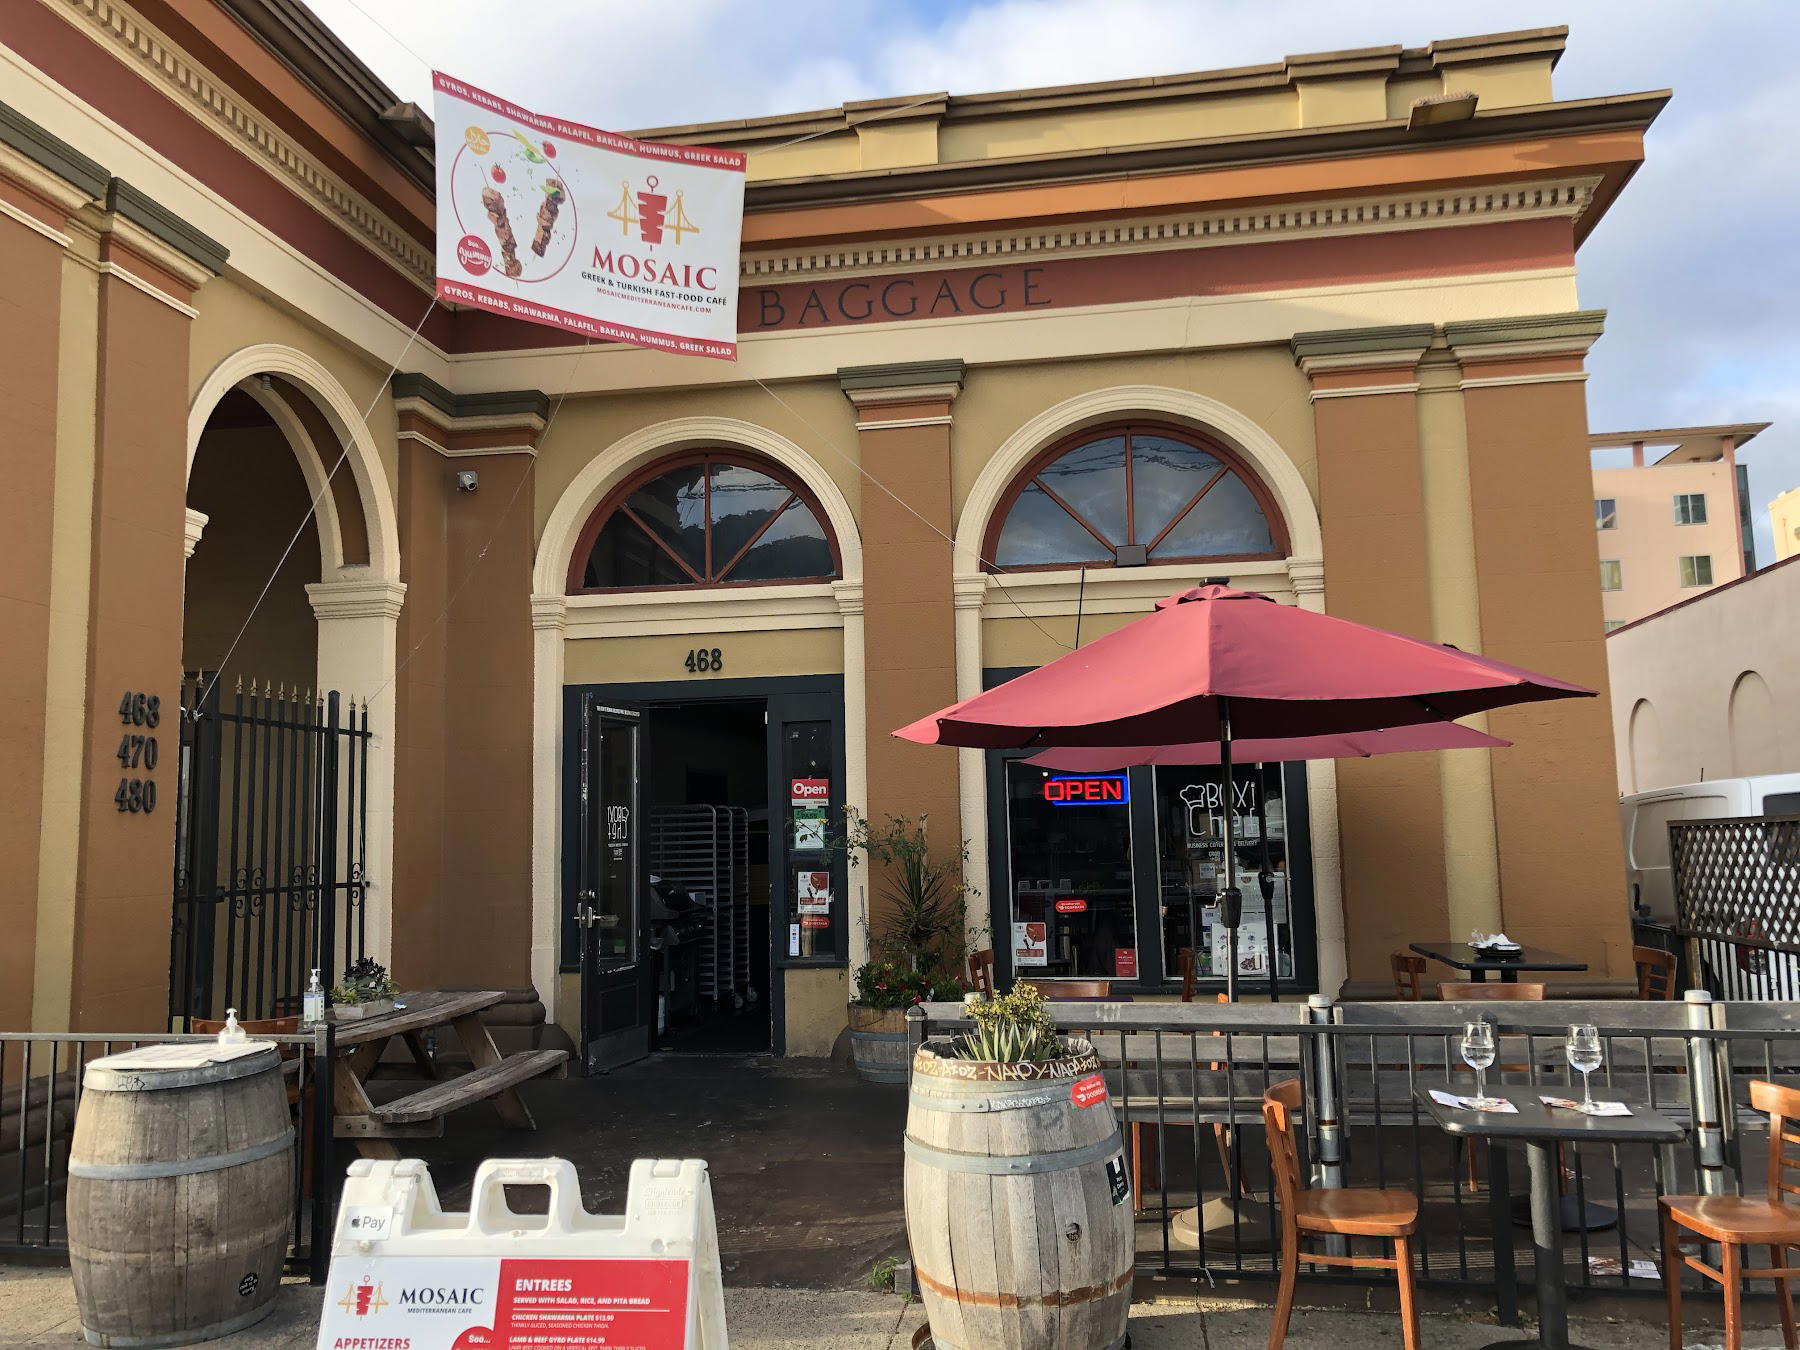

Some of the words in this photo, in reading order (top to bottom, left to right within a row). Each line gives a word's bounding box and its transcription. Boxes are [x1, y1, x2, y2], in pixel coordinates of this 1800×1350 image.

[439, 78, 470, 98] GYROS,
[472, 92, 505, 112] KEBABS,
[506, 106, 556, 132] SHAWARMA,
[557, 125, 594, 142] FALAFEL,
[596, 135, 637, 152] BAKLAVA,
[640, 145, 682, 159] HUMMUS,
[684, 152, 710, 162] GREEK
[713, 156, 741, 166] SALAD
[592, 245, 718, 292] MOSAIC
[581, 271, 606, 285] GREEK
[616, 282, 652, 295] TURKISH
[654, 289, 704, 302] FAST-FOOD
[706, 296, 728, 306] CAFÉ
[758, 268, 1052, 328] BAGGAGE
[444, 286, 476, 302] GYROS,
[478, 294, 511, 312] KEBABS,
[512, 304, 562, 324] SHAWARMA,
[564, 318, 598, 333] FALAFEL,
[600, 326, 638, 342] BAKLAVA,
[640, 334, 678, 348] HUMMUS,
[680, 342, 704, 353] GREEK
[706, 346, 732, 356] SALAD
[684, 648, 722, 672] 468
[118, 691, 160, 728] 468
[117, 735, 158, 770] 470
[114, 778, 156, 814] 480
[794, 782, 827, 797] Open
[1044, 781, 1122, 800] OPEN
[362, 1216, 386, 1232] Pay
[399, 1288, 484, 1304] MOSAIC
[515, 1278, 572, 1292] ENTREES
[556, 1297, 578, 1306] SALAD,
[580, 1297, 596, 1306] RICE,
[628, 1297, 650, 1305] BREAD
[334, 1338, 410, 1350] APPETIZERS
[548, 1336, 566, 1344] GYRO
[567, 1336, 586, 1344] PLATE
